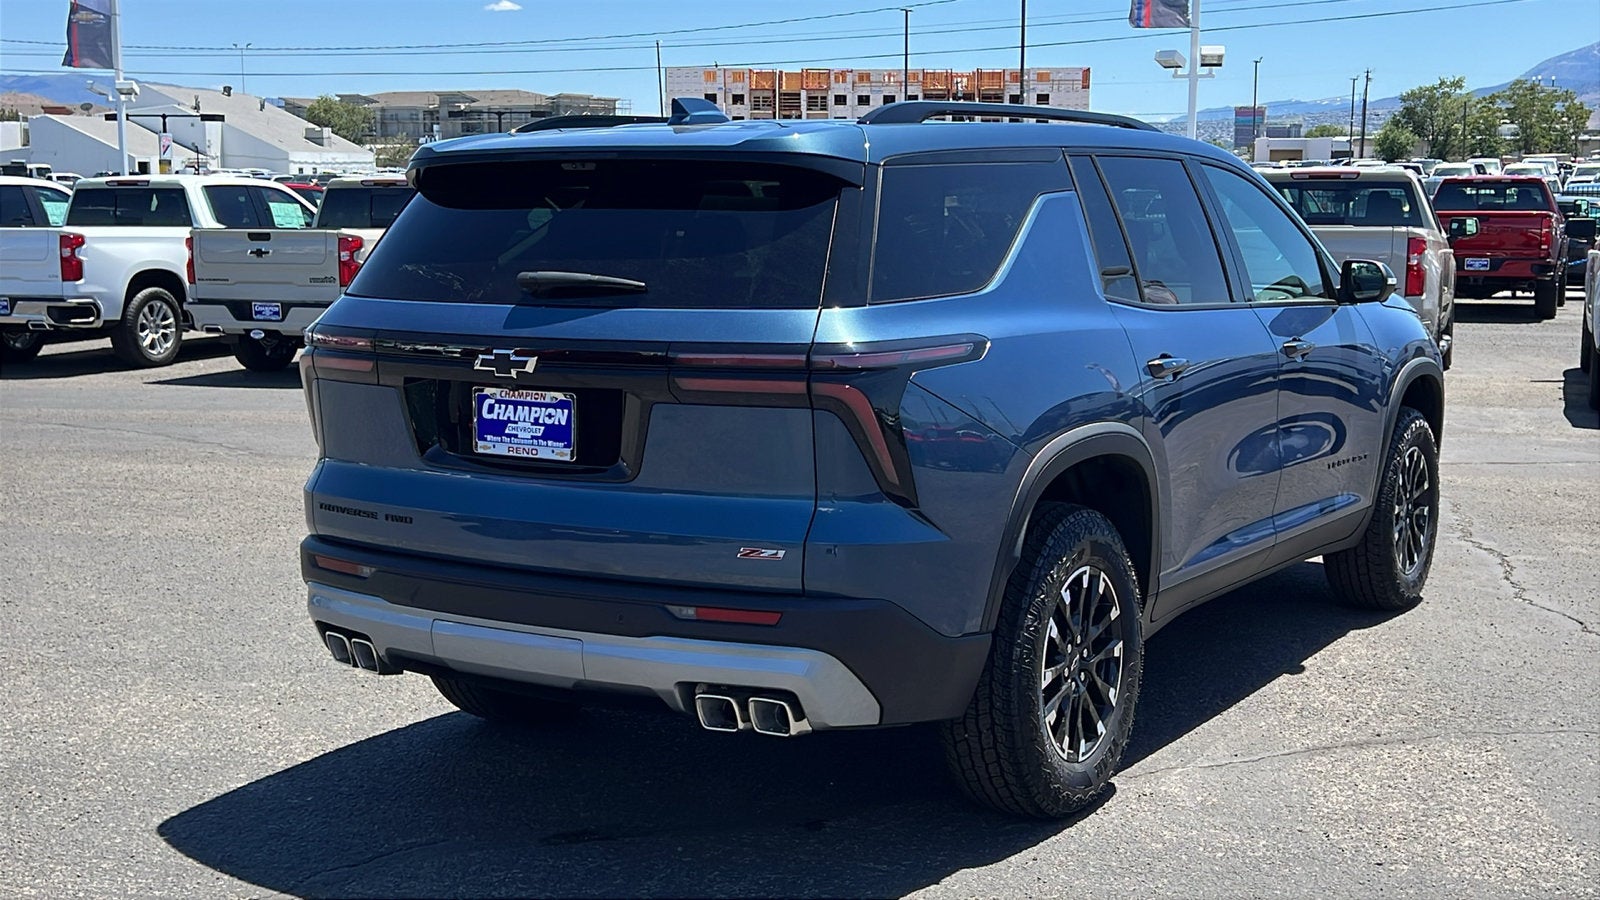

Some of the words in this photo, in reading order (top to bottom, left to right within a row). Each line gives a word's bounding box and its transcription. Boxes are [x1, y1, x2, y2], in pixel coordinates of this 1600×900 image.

[499, 390, 547, 401] CHAMPION
[482, 399, 568, 425] CHAMPION
[507, 425, 542, 434] CHEVROLET
[507, 446, 539, 456] RENO
[737, 547, 786, 560] Z71
